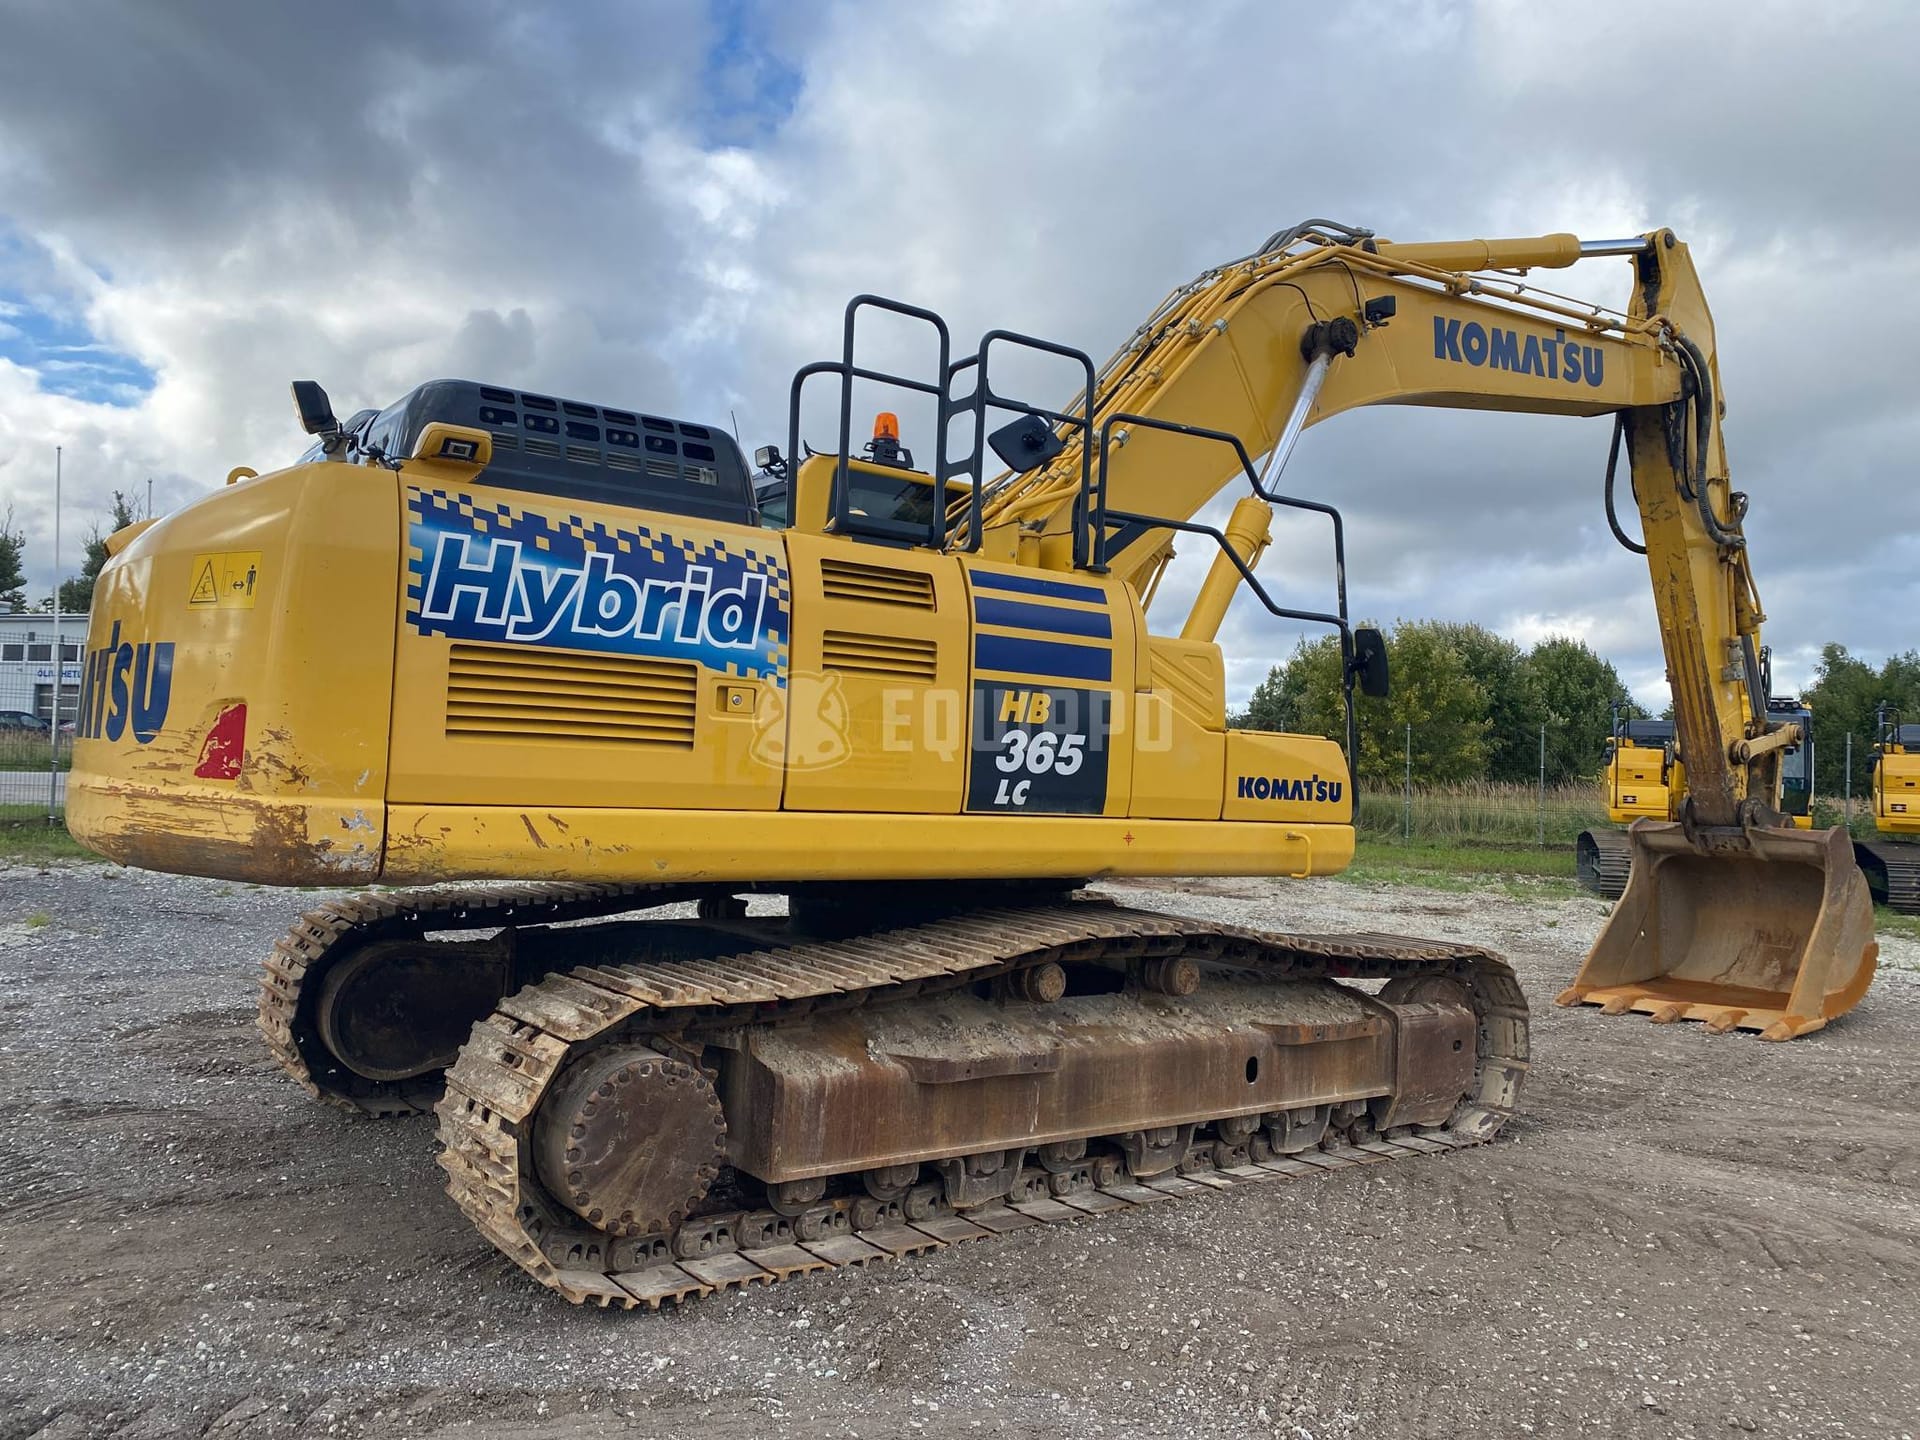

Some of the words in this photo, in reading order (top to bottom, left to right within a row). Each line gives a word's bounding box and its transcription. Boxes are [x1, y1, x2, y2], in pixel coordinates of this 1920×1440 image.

[1433, 315, 1604, 388] KOMATSU
[421, 531, 767, 650] Hybrid
[998, 690, 1051, 724] HB
[995, 729, 1086, 776] 365
[993, 778, 1031, 806] LC
[1238, 774, 1342, 803] KOMATSU
